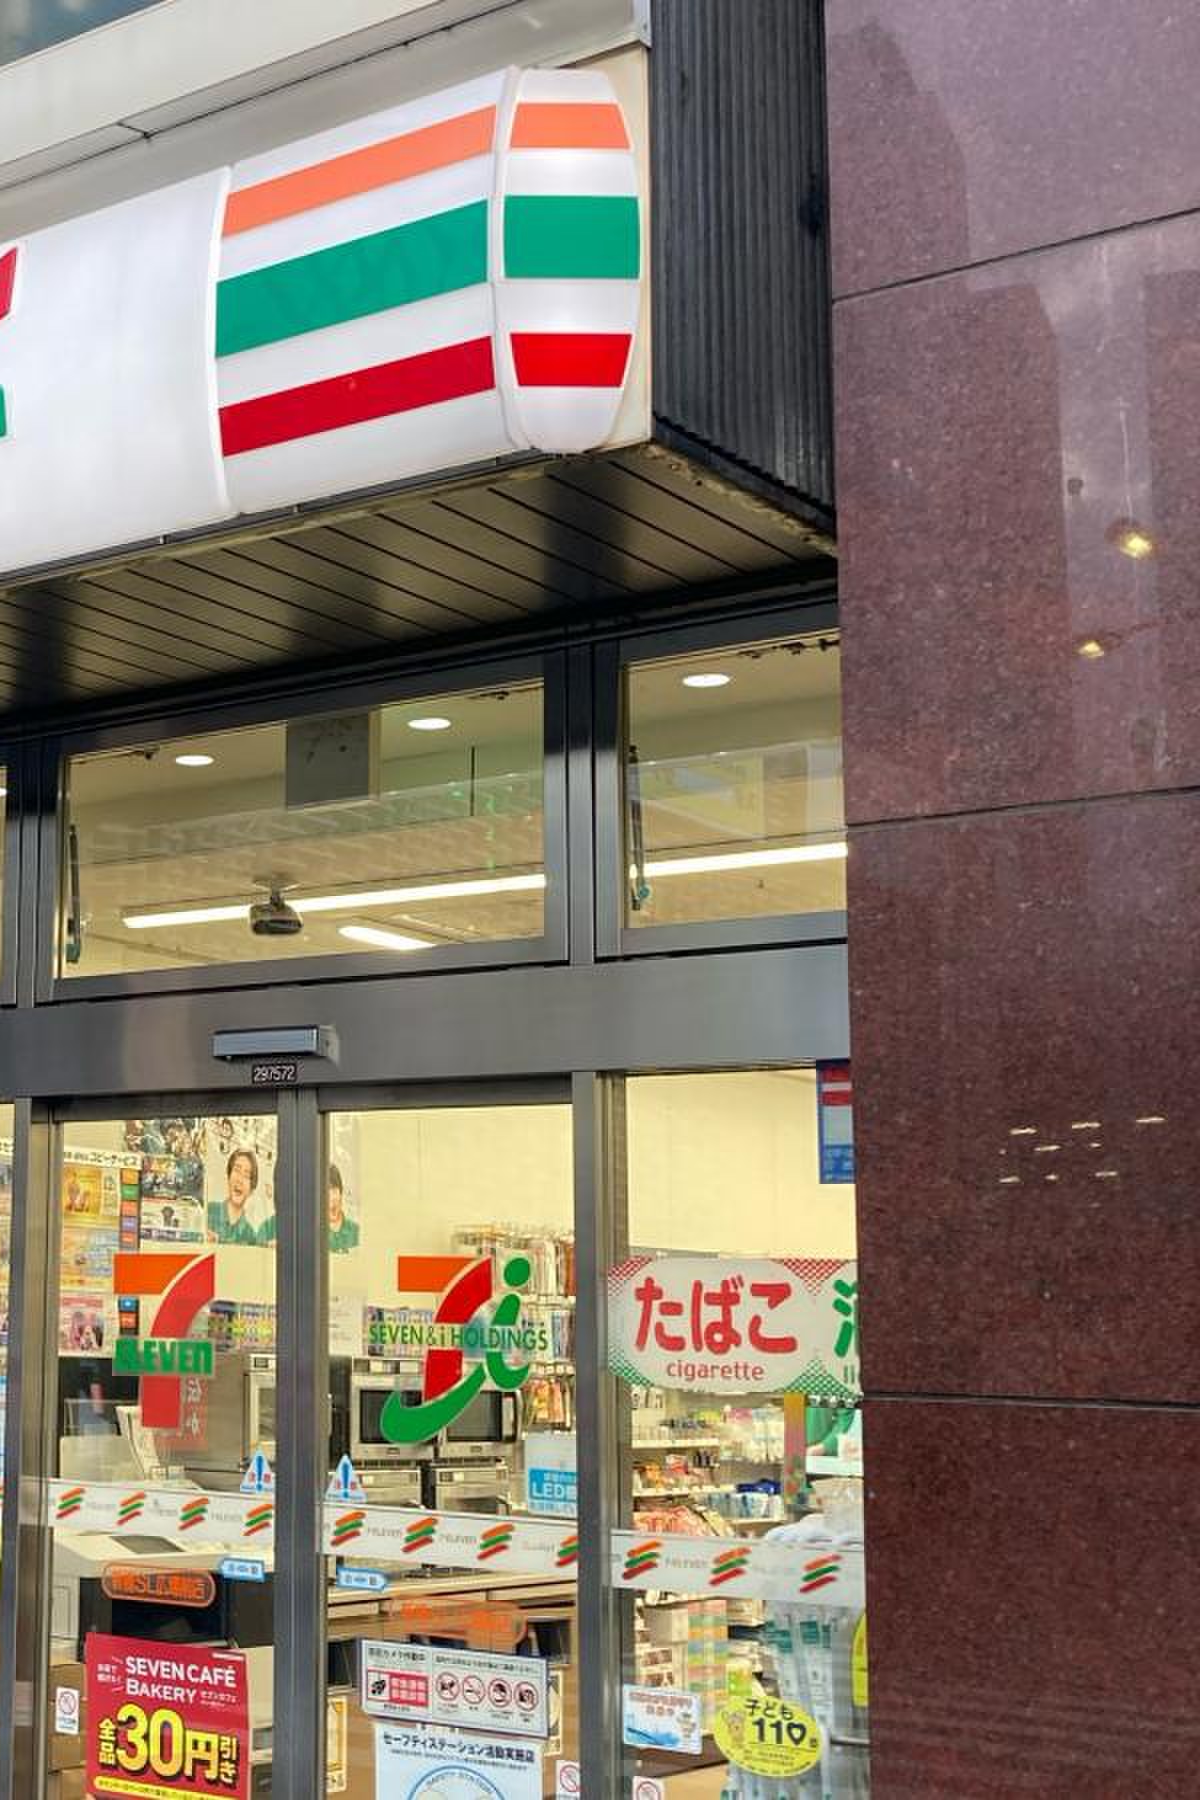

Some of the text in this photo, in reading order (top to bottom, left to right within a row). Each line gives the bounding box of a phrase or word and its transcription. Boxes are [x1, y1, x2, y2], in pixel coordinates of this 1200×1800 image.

[633, 1275, 798, 1354] たばこ
[451, 1327, 548, 1351] HOLDINGS
[666, 1360, 765, 1380] cigarette
[126, 1655, 185, 1681] SEVEN
[187, 1663, 237, 1689] CAFÉ
[126, 1679, 197, 1705] BAKERY
[744, 1698, 794, 1721] 子ども
[382, 1731, 536, 1763] セーフティステーション活動実施店
